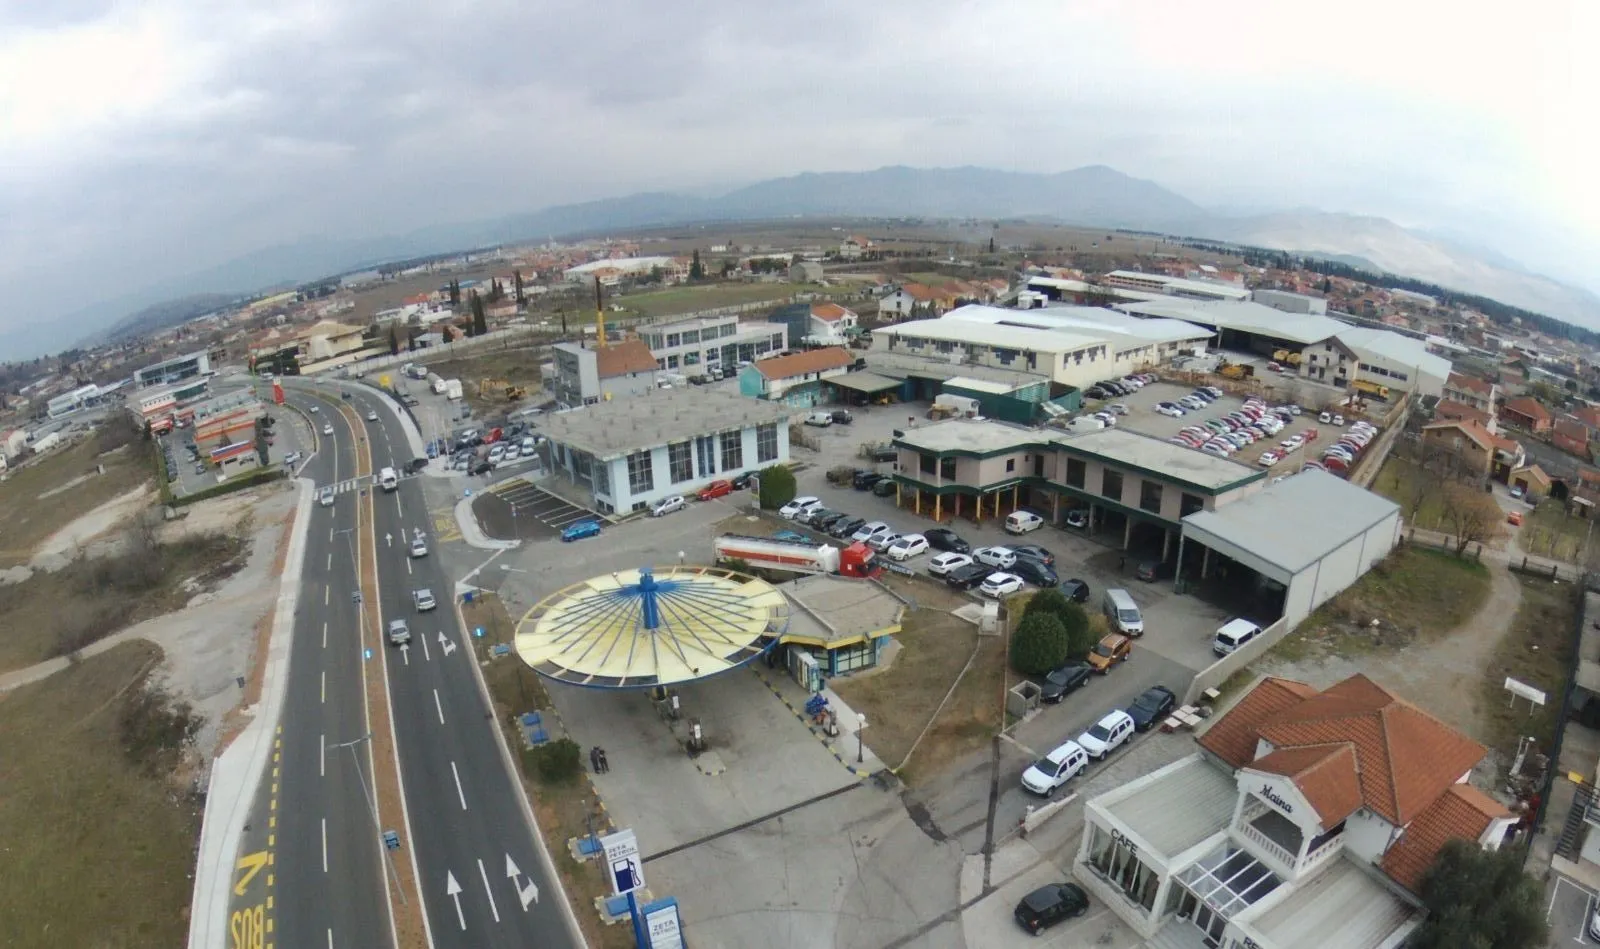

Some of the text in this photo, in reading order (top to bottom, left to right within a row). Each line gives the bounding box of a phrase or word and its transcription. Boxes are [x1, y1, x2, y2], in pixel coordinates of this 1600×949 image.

[1260, 784, 1293, 813] Maina
[608, 844, 627, 853] ZETA
[1111, 828, 1138, 857] CAFE
[609, 846, 637, 858] PETROL
[653, 919, 675, 931] ZETA
